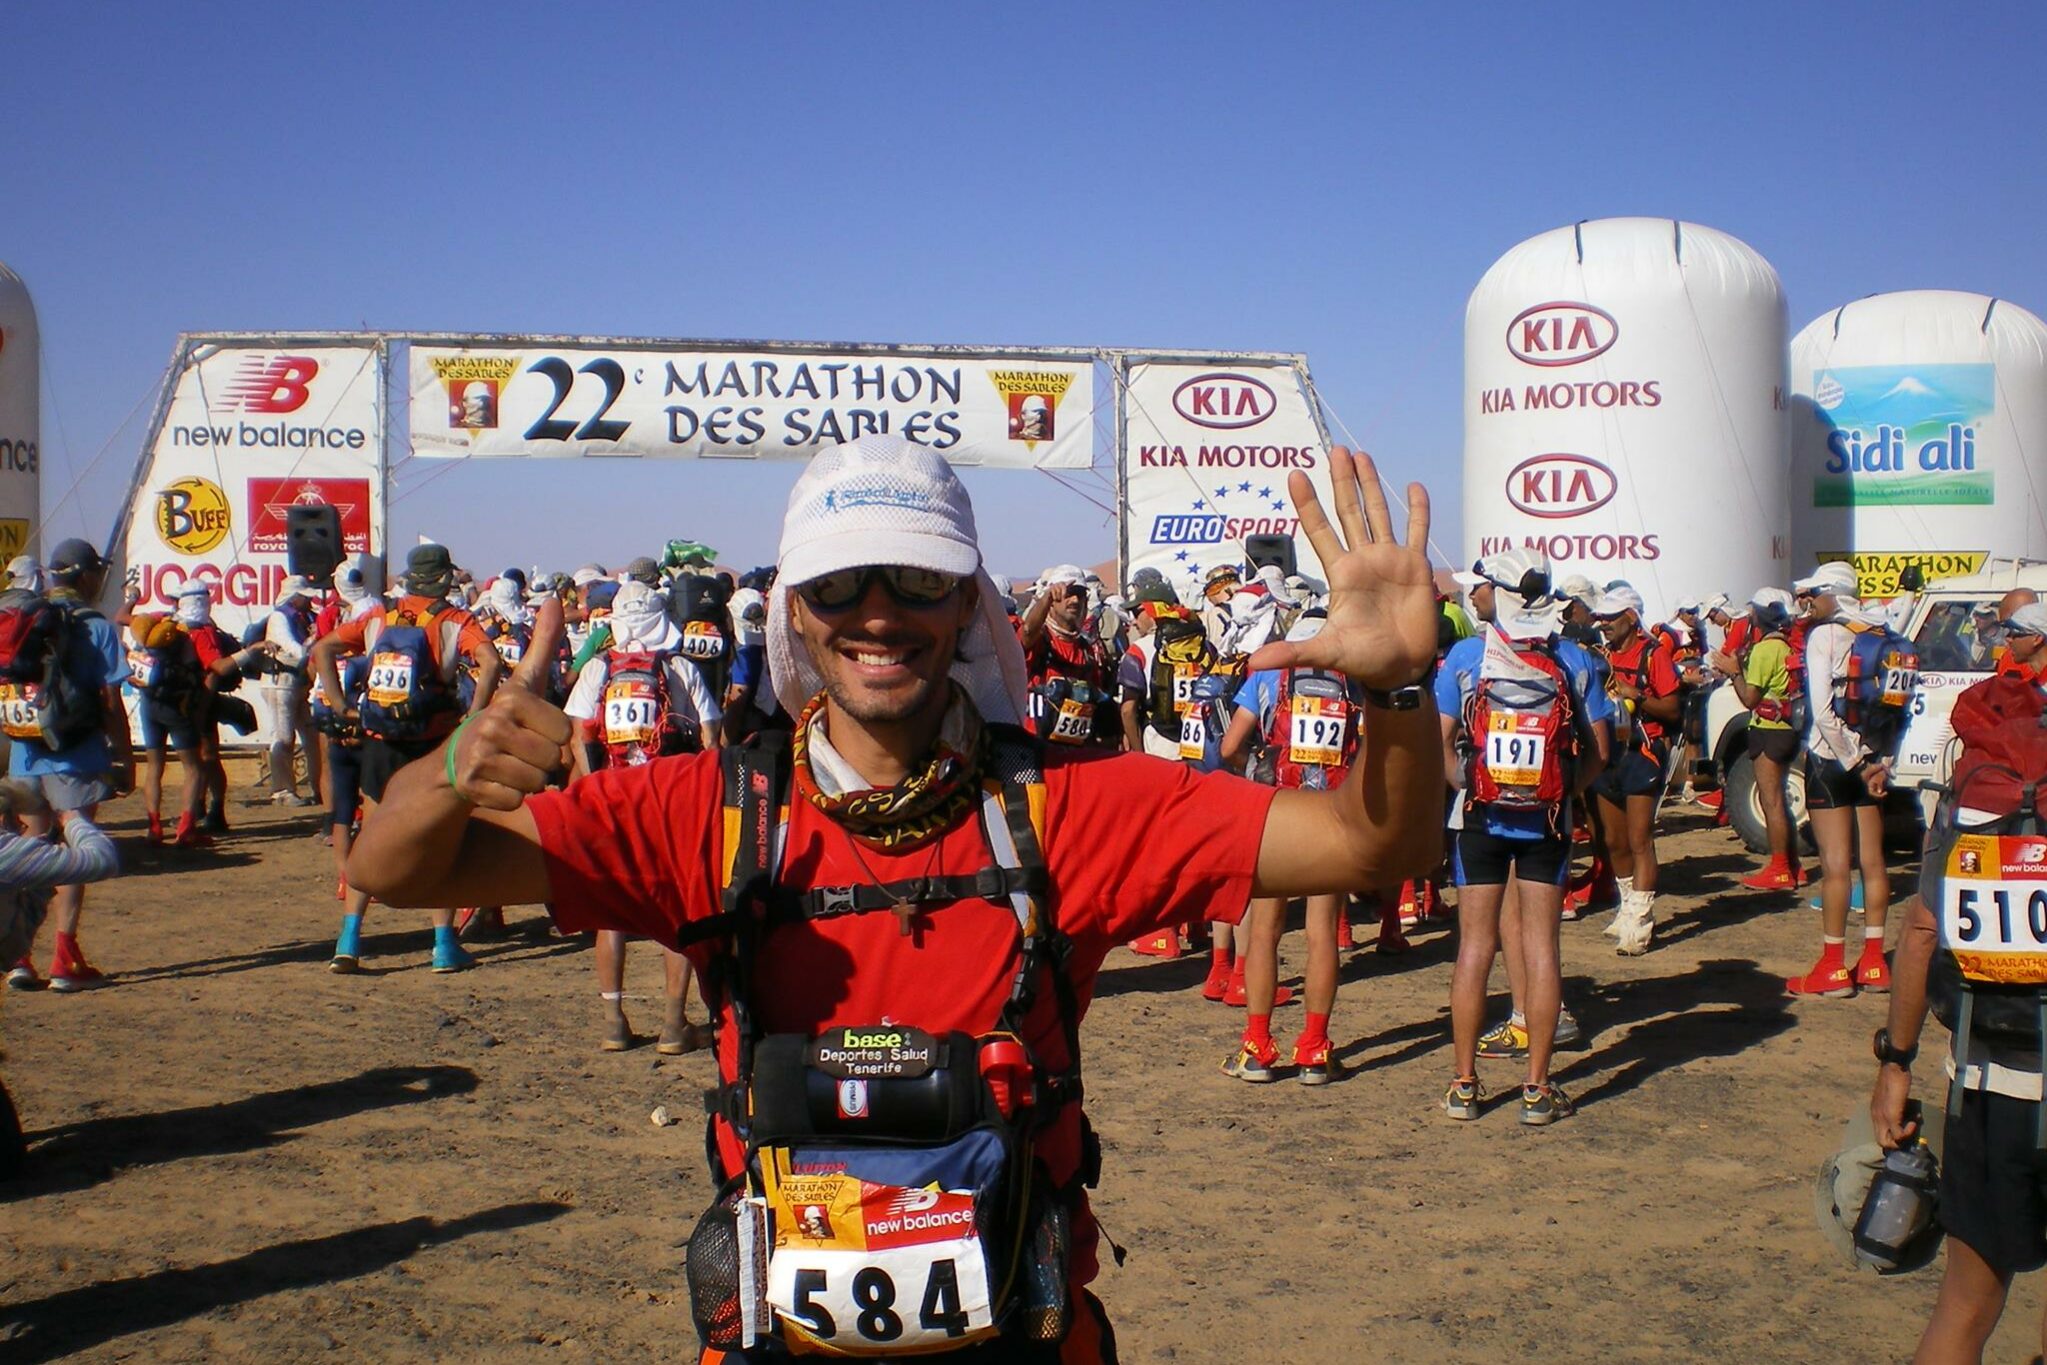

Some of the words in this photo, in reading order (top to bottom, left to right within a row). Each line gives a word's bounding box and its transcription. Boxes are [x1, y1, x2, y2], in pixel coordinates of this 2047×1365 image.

[1522, 315, 1598, 353] KIA
[434, 357, 514, 369] MARATHON
[438, 368, 466, 379] DES
[466, 368, 511, 379] SABLES
[663, 359, 962, 405] MARATHON
[994, 371, 1069, 383] MARATHON
[998, 381, 1022, 392] DES
[1023, 382, 1066, 394] SABLES
[1191, 386, 1262, 416] KIA
[1481, 385, 1517, 414] KIA
[1523, 380, 1662, 411] MOTORS
[173, 426, 233, 447] new
[239, 420, 366, 449] balance
[663, 404, 766, 446] DES
[1139, 445, 1189, 468] KIA
[1197, 444, 1316, 469] MOTORS
[1825, 424, 1904, 474] Sidi
[1918, 423, 1975, 472] ali
[1522, 468, 1597, 503] KIA
[253, 542, 289, 552] roya
[343, 541, 364, 551] roc
[1480, 536, 1513, 558] KIA
[1523, 533, 1661, 561] MOTORS
[1854, 555, 1972, 574] ARATHON
[138, 562, 305, 606] JOGGIN
[688, 637, 719, 655] 406
[372, 668, 408, 689] 396
[611, 702, 649, 725] 361
[1182, 721, 1201, 743] 86
[1298, 719, 1340, 747] 192
[1494, 737, 1537, 765] 191
[756, 797, 769, 844] balance
[757, 844, 769, 869] new
[2001, 864, 2023, 873] new
[2023, 863, 2047, 873] bala
[1958, 888, 2047, 944] 510
[1987, 957, 2047, 968] MARATH
[843, 1028, 902, 1049] base
[819, 1049, 883, 1065] Deportes
[845, 1062, 902, 1075] Tenerife
[783, 1183, 838, 1193] MARATHON
[866, 1219, 902, 1236] new
[902, 1209, 973, 1231] balance
[793, 1258, 969, 1342] 584
